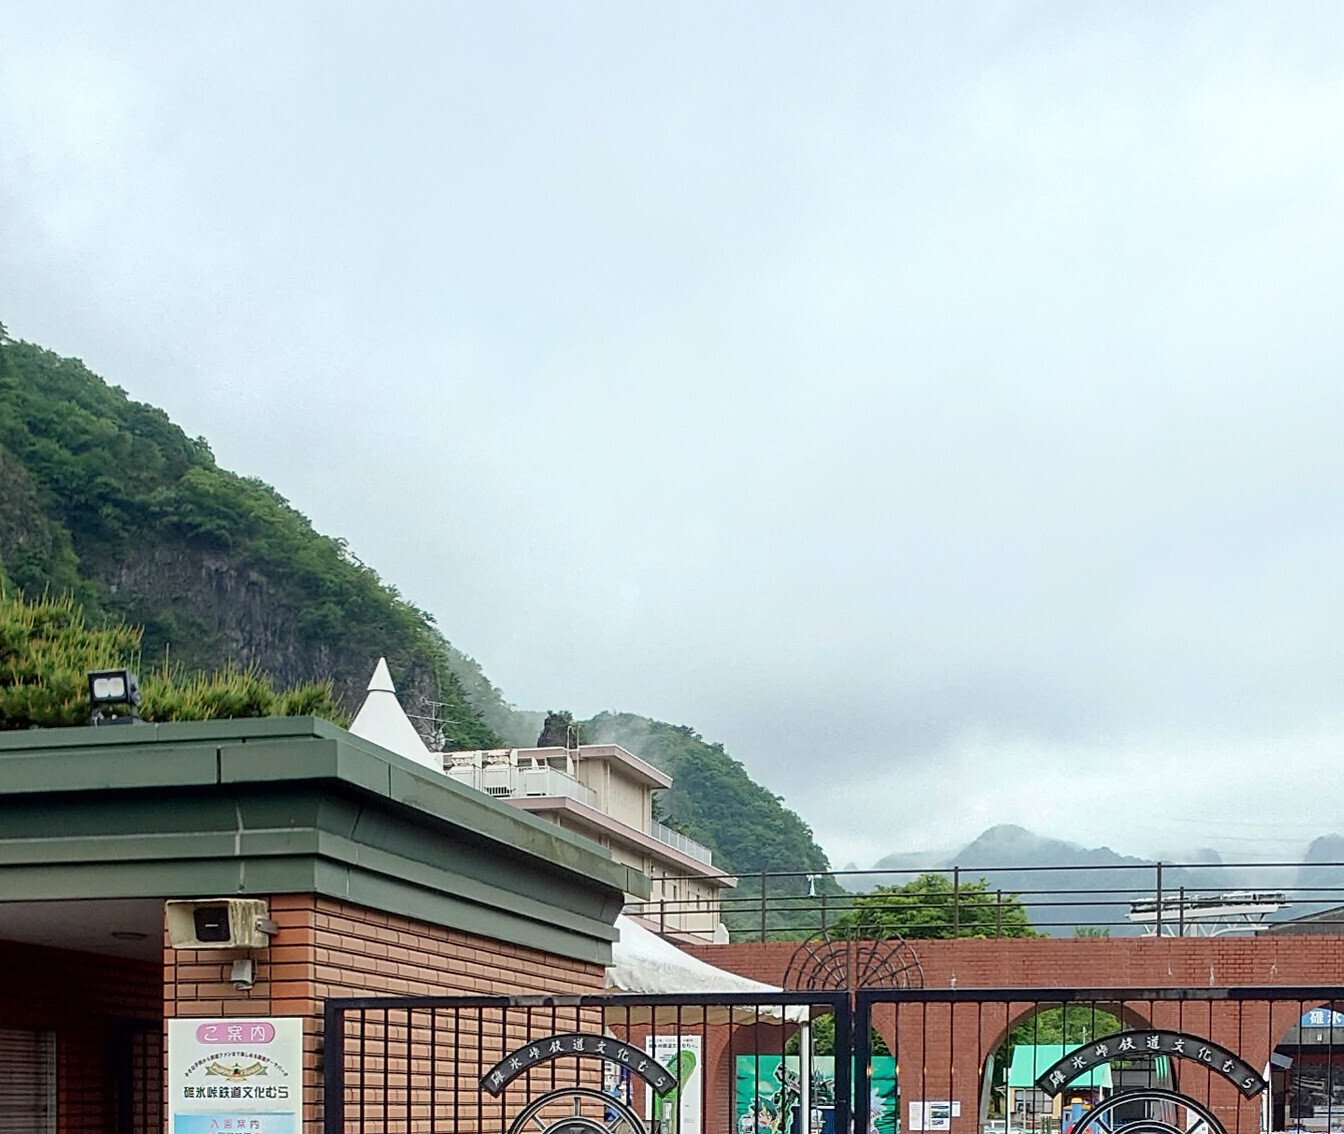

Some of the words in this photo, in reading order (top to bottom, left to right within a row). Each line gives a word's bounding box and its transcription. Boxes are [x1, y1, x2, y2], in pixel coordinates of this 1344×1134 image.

[203, 1024, 268, 1043] ご案内
[490, 1037, 665, 1088] 碓氷峠鉄道文化むら
[1049, 1035, 1255, 1089] 碓氷峠鉄道文化むら
[184, 1086, 289, 1099] 碓氷峠鉄道文化むら
